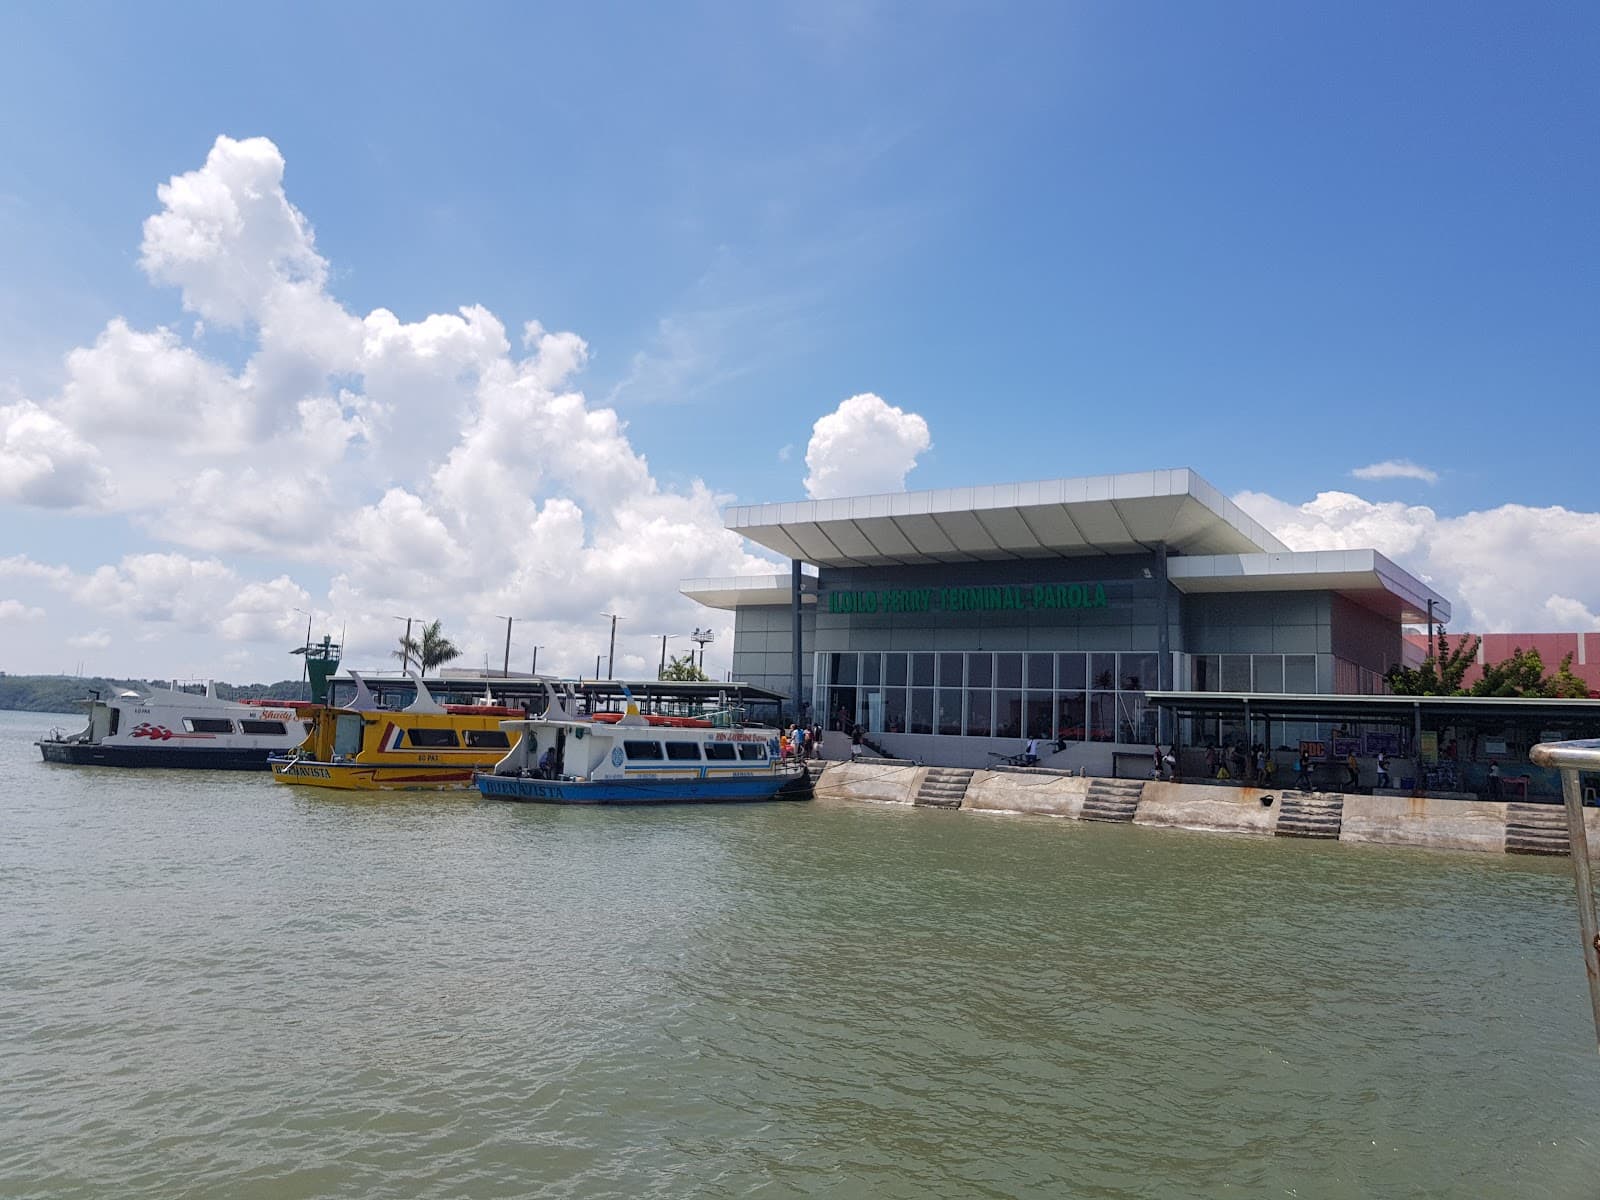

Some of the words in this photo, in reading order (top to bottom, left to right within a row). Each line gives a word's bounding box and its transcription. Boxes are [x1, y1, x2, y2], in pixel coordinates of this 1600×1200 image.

[829, 591, 878, 614] ILOILO
[882, 589, 932, 613] FERRY
[940, 586, 1025, 612] TERMINAL
[1033, 582, 1107, 609] PAROLA
[275, 765, 331, 779] BUENAVISTA
[486, 781, 564, 798] BUENAVISTA
